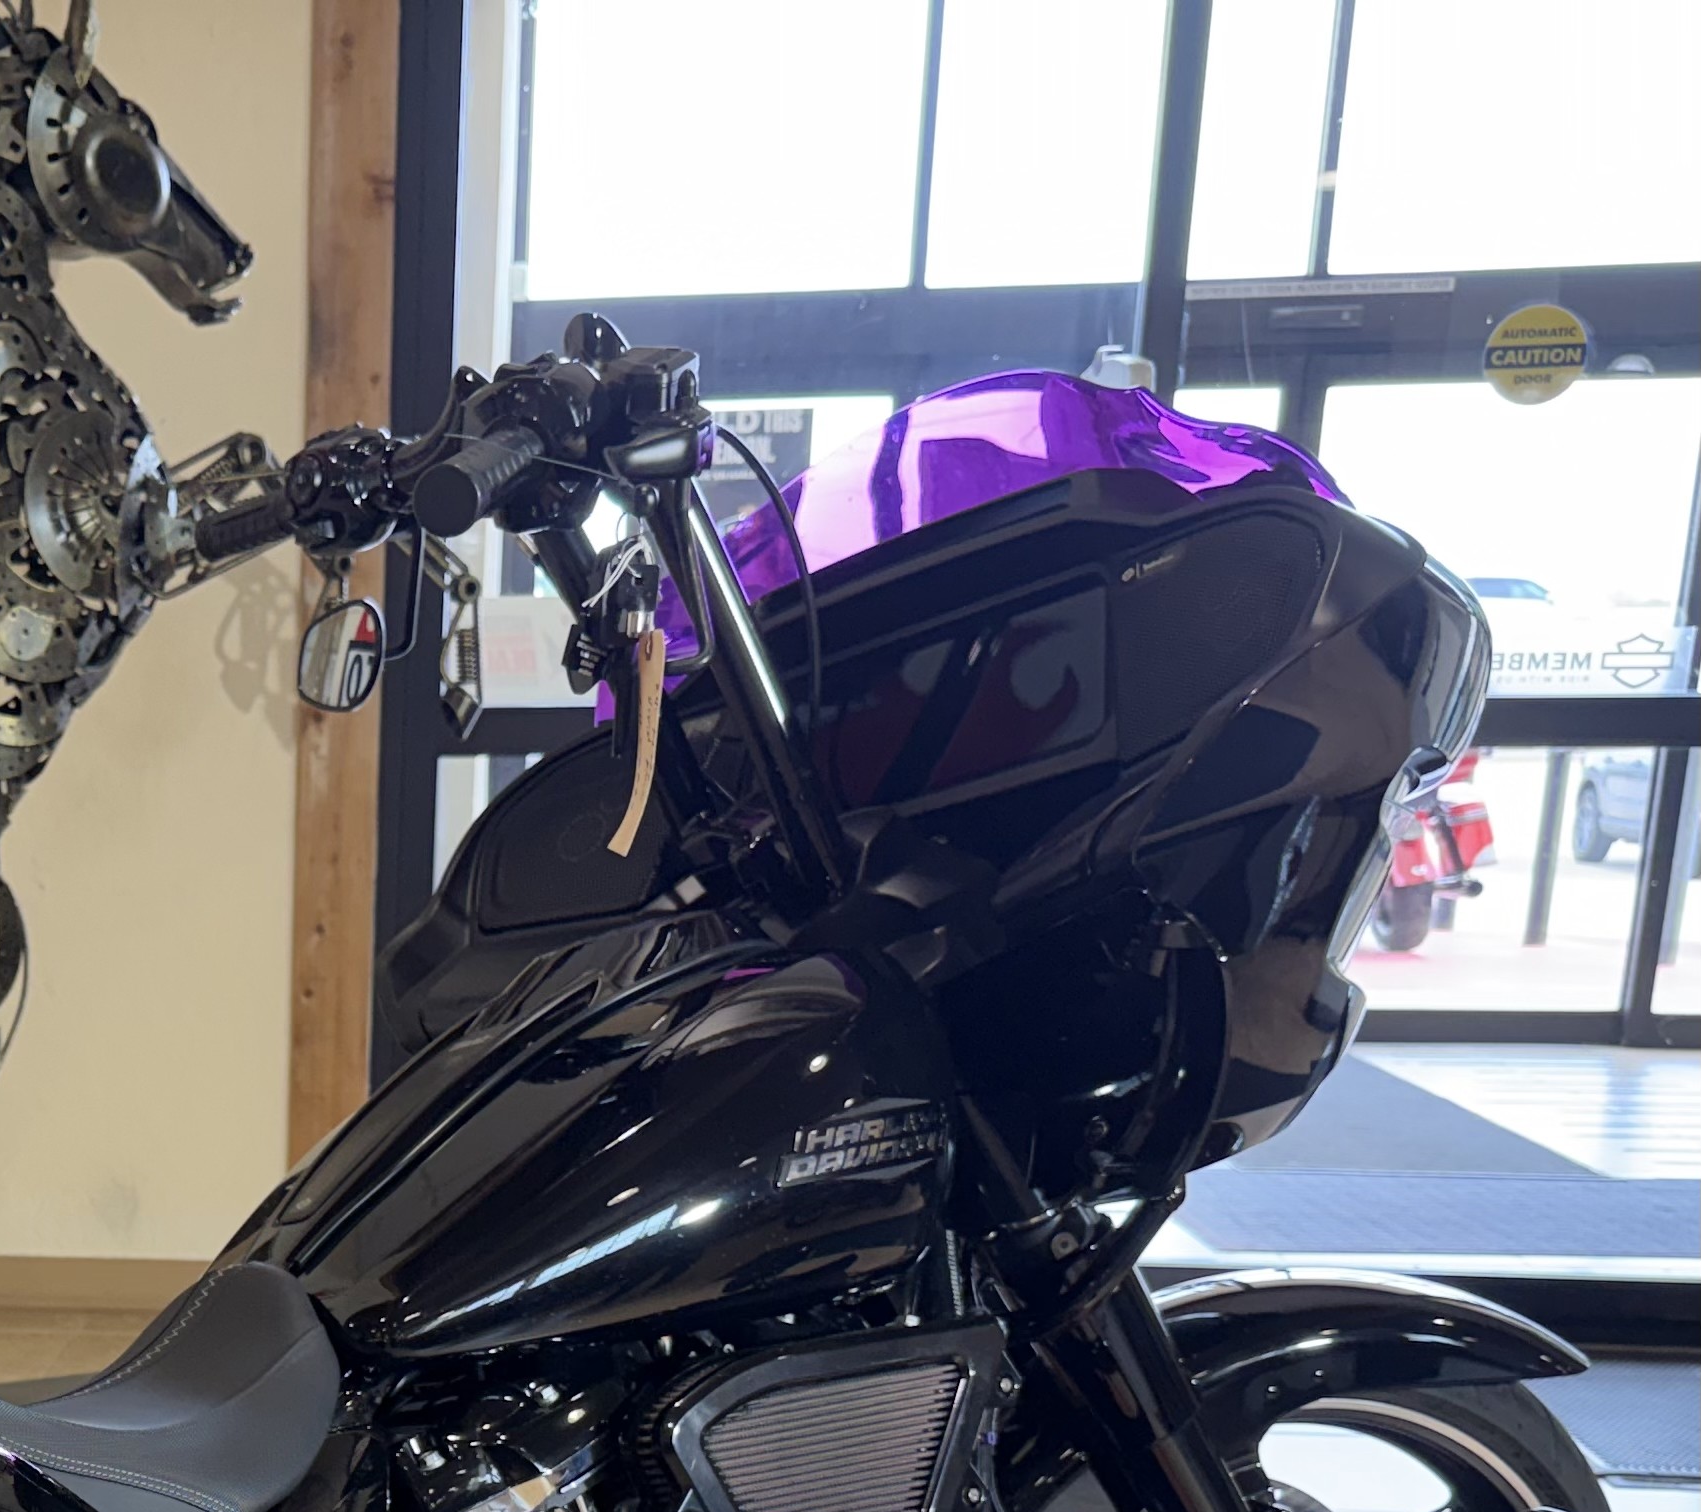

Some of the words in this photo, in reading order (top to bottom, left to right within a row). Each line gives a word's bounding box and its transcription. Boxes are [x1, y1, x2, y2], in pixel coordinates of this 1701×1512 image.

[1501, 327, 1577, 339] AUTOMATIC
[1490, 347, 1582, 366] CAUTION
[1514, 374, 1553, 385] DOOR
[805, 1112, 946, 1154] HARL
[786, 1131, 946, 1182] DAVID
